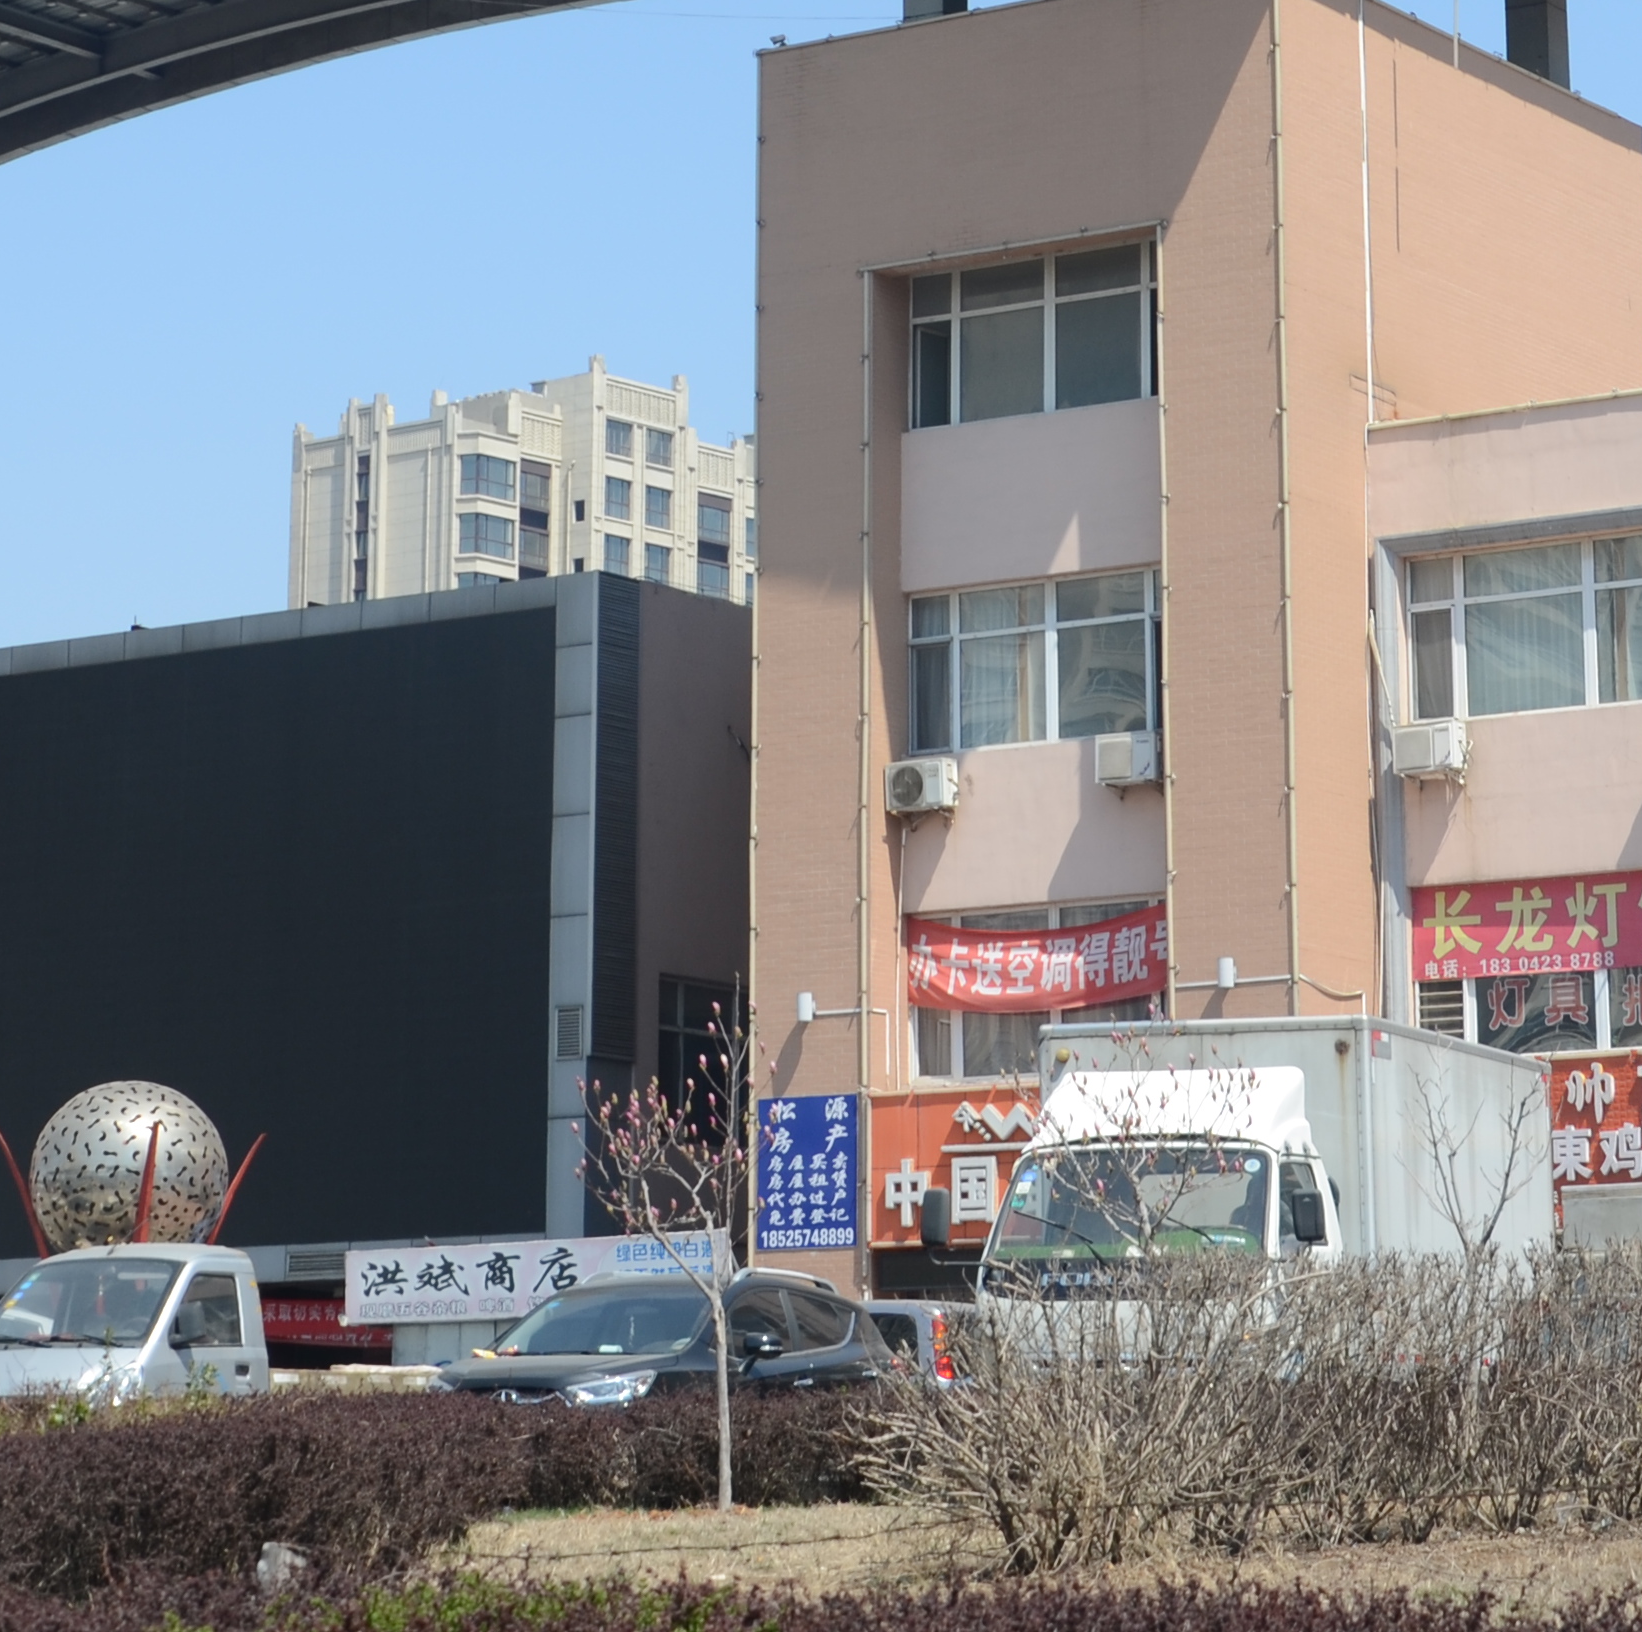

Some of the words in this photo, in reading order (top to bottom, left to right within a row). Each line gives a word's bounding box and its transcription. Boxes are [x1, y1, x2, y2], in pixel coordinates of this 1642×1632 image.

[1479, 958, 1511, 976] 183
[1518, 955, 1562, 974] 0423
[1570, 951, 1615, 969] 8788
[769, 1124, 849, 1155] 房产
[767, 1151, 848, 1172] 房屋买卖
[767, 1169, 847, 1190] 房屋租赁
[767, 1188, 847, 1208] 代办过户
[885, 1155, 999, 1228] 中国
[769, 1207, 849, 1226] 免费登记
[761, 1227, 854, 1248] 18525748899
[360, 1247, 580, 1298] 洪斌商店
